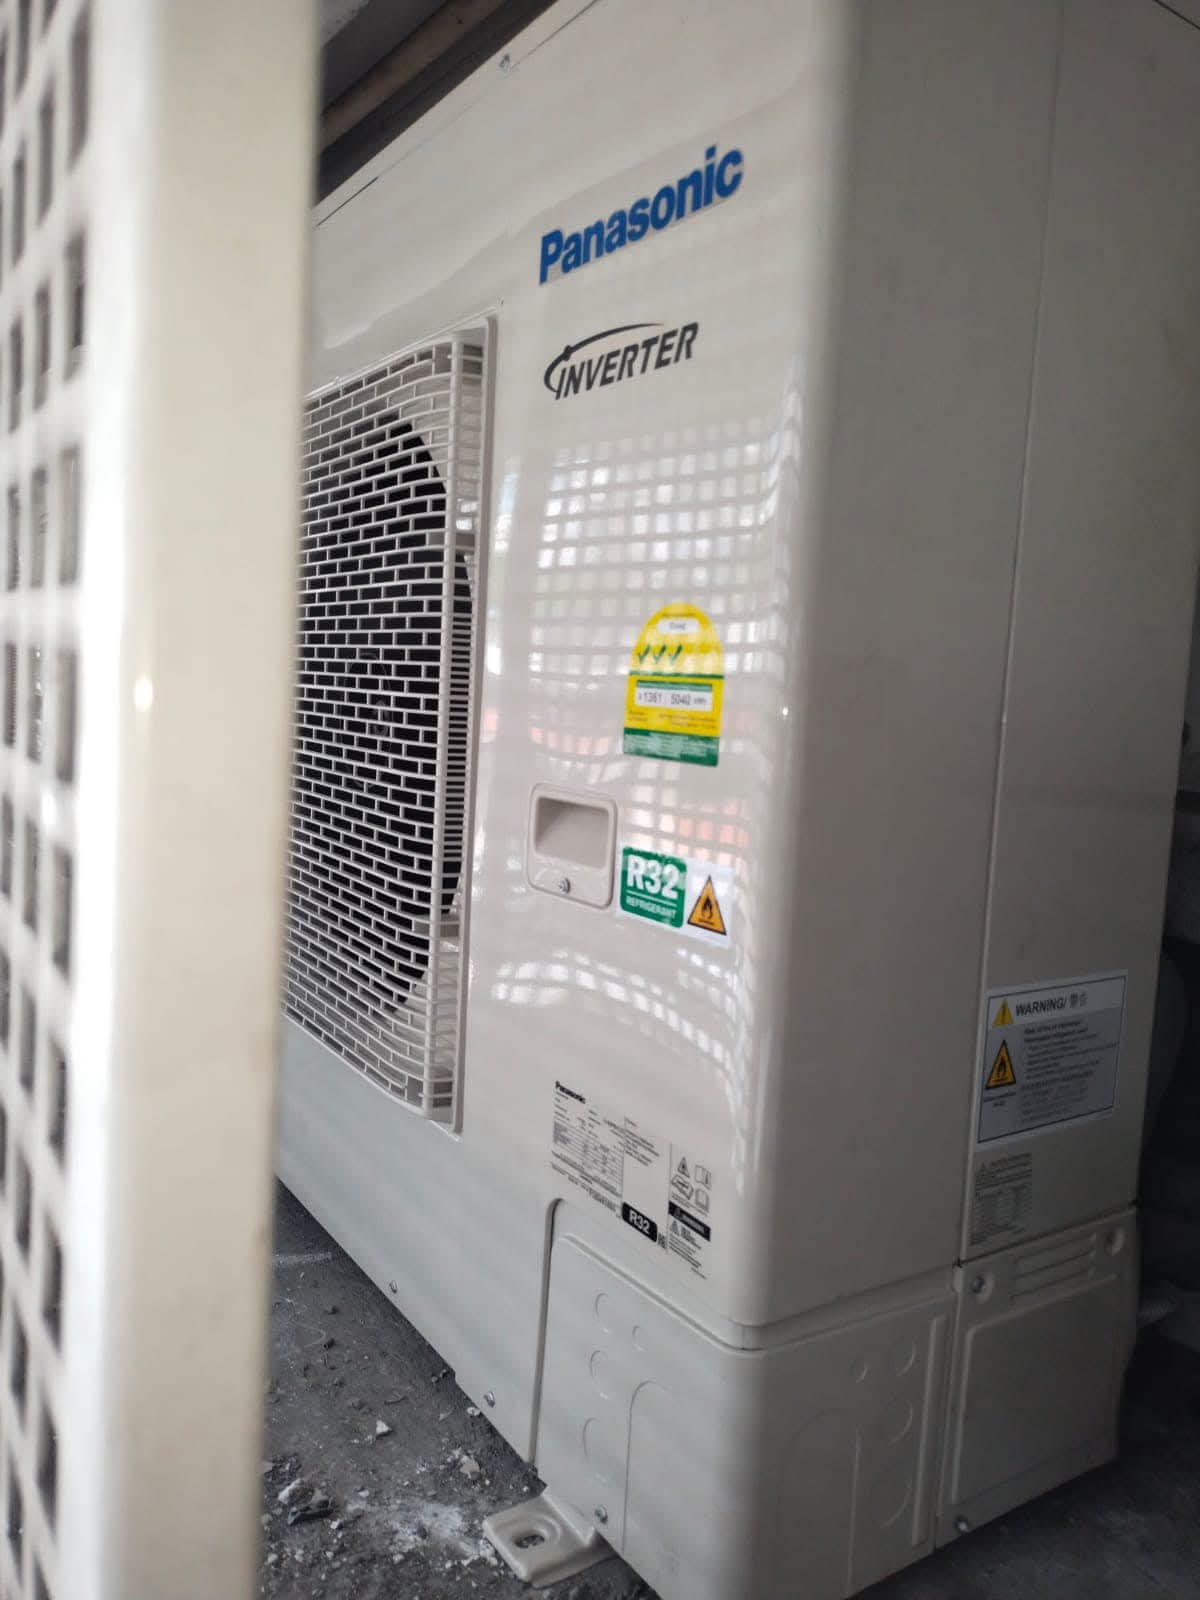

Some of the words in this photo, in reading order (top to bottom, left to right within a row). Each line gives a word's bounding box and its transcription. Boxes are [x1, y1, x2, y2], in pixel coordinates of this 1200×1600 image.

[539, 144, 743, 285] Panasonic
[554, 322, 698, 400] INVERTER
[627, 854, 679, 899] R32
[629, 1211, 650, 1235] R32
